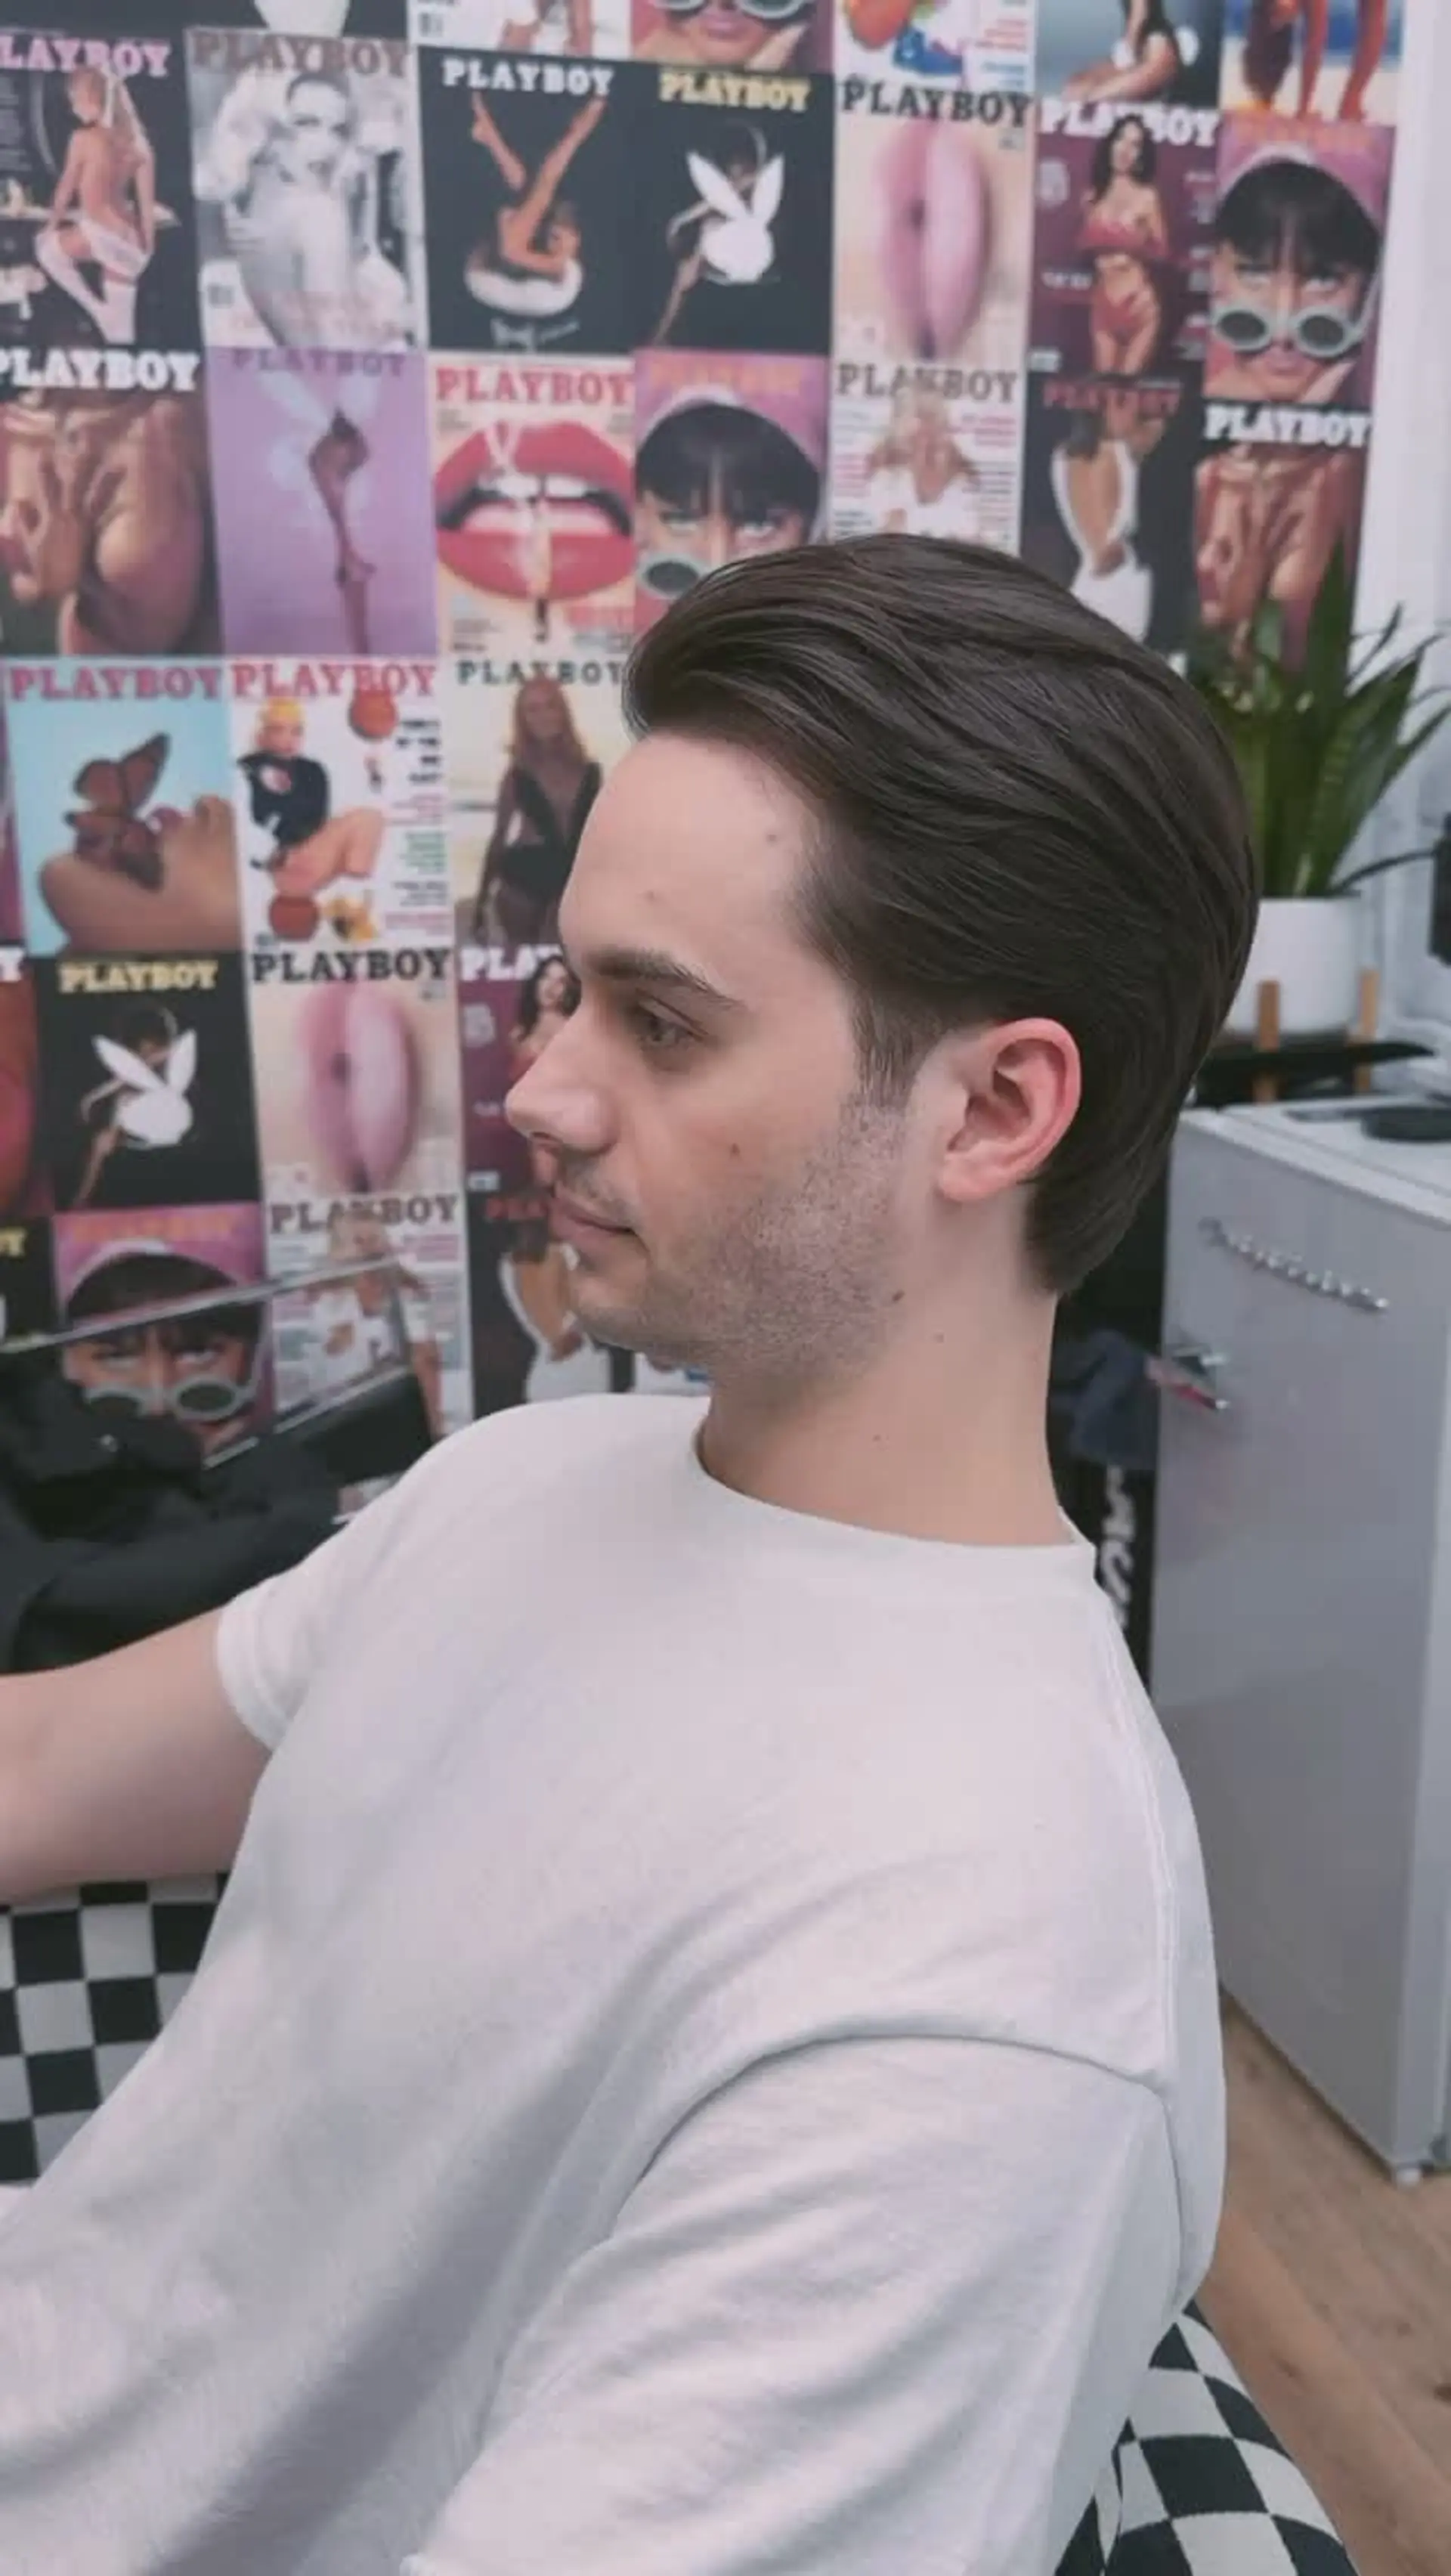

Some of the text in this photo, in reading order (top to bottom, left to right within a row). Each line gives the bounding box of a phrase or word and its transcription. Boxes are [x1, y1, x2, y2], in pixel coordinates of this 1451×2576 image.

[194, 33, 408, 76] PLAYBOY
[442, 59, 614, 95] PLAYBOY
[659, 70, 810, 112] PLAYBOY
[840, 81, 1031, 126] PLAYBOY
[230, 347, 407, 378] PLAYBOY
[435, 367, 634, 405] PLAYBOY
[1204, 404, 1373, 448] PLAYBOY
[11, 666, 221, 701] PLAYBOY
[231, 663, 438, 697] PLAYBOY
[58, 960, 219, 992] PLAYBOY
[252, 947, 452, 983] PLAYBOY
